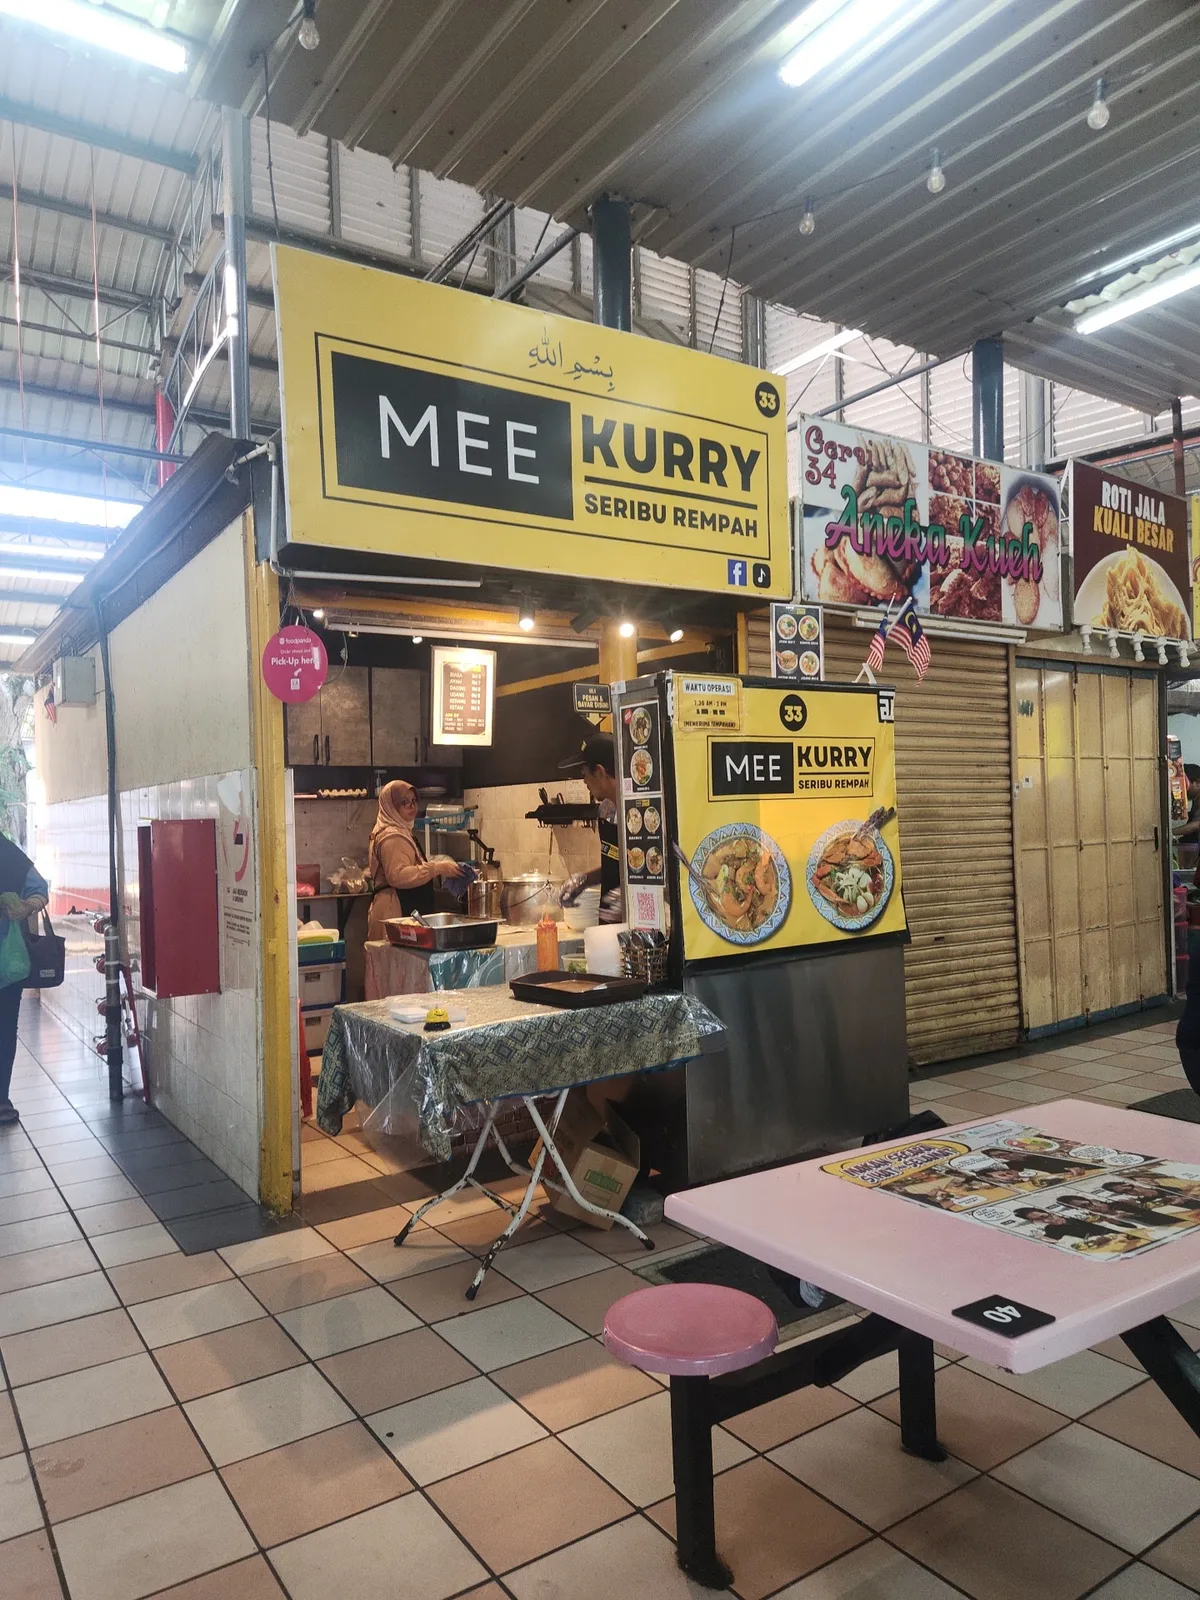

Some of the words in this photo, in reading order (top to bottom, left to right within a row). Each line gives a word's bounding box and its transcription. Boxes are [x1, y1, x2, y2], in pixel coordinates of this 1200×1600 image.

[759, 391, 776, 410] 33
[379, 395, 540, 484] MEE
[581, 414, 761, 492] KURRY
[805, 455, 836, 489] 34
[584, 493, 666, 524] SERIBU
[673, 508, 758, 539] REMPAH
[1101, 481, 1131, 514] ROTI
[1134, 492, 1166, 526] JALA
[825, 484, 951, 568] Aneka
[959, 513, 1044, 584] Kueh
[1093, 505, 1134, 541] KUALI
[1137, 519, 1174, 554] BESAR
[271, 657, 299, 667] Pick-Up
[685, 683, 706, 692] WAKTU
[707, 683, 732, 693] OPERASI
[784, 705, 803, 723] 33
[725, 754, 782, 782] MEE
[797, 746, 872, 767] KURRY
[798, 778, 833, 789] SERIBU
[834, 778, 869, 789] REMPAH
[982, 1304, 1022, 1323] 40
